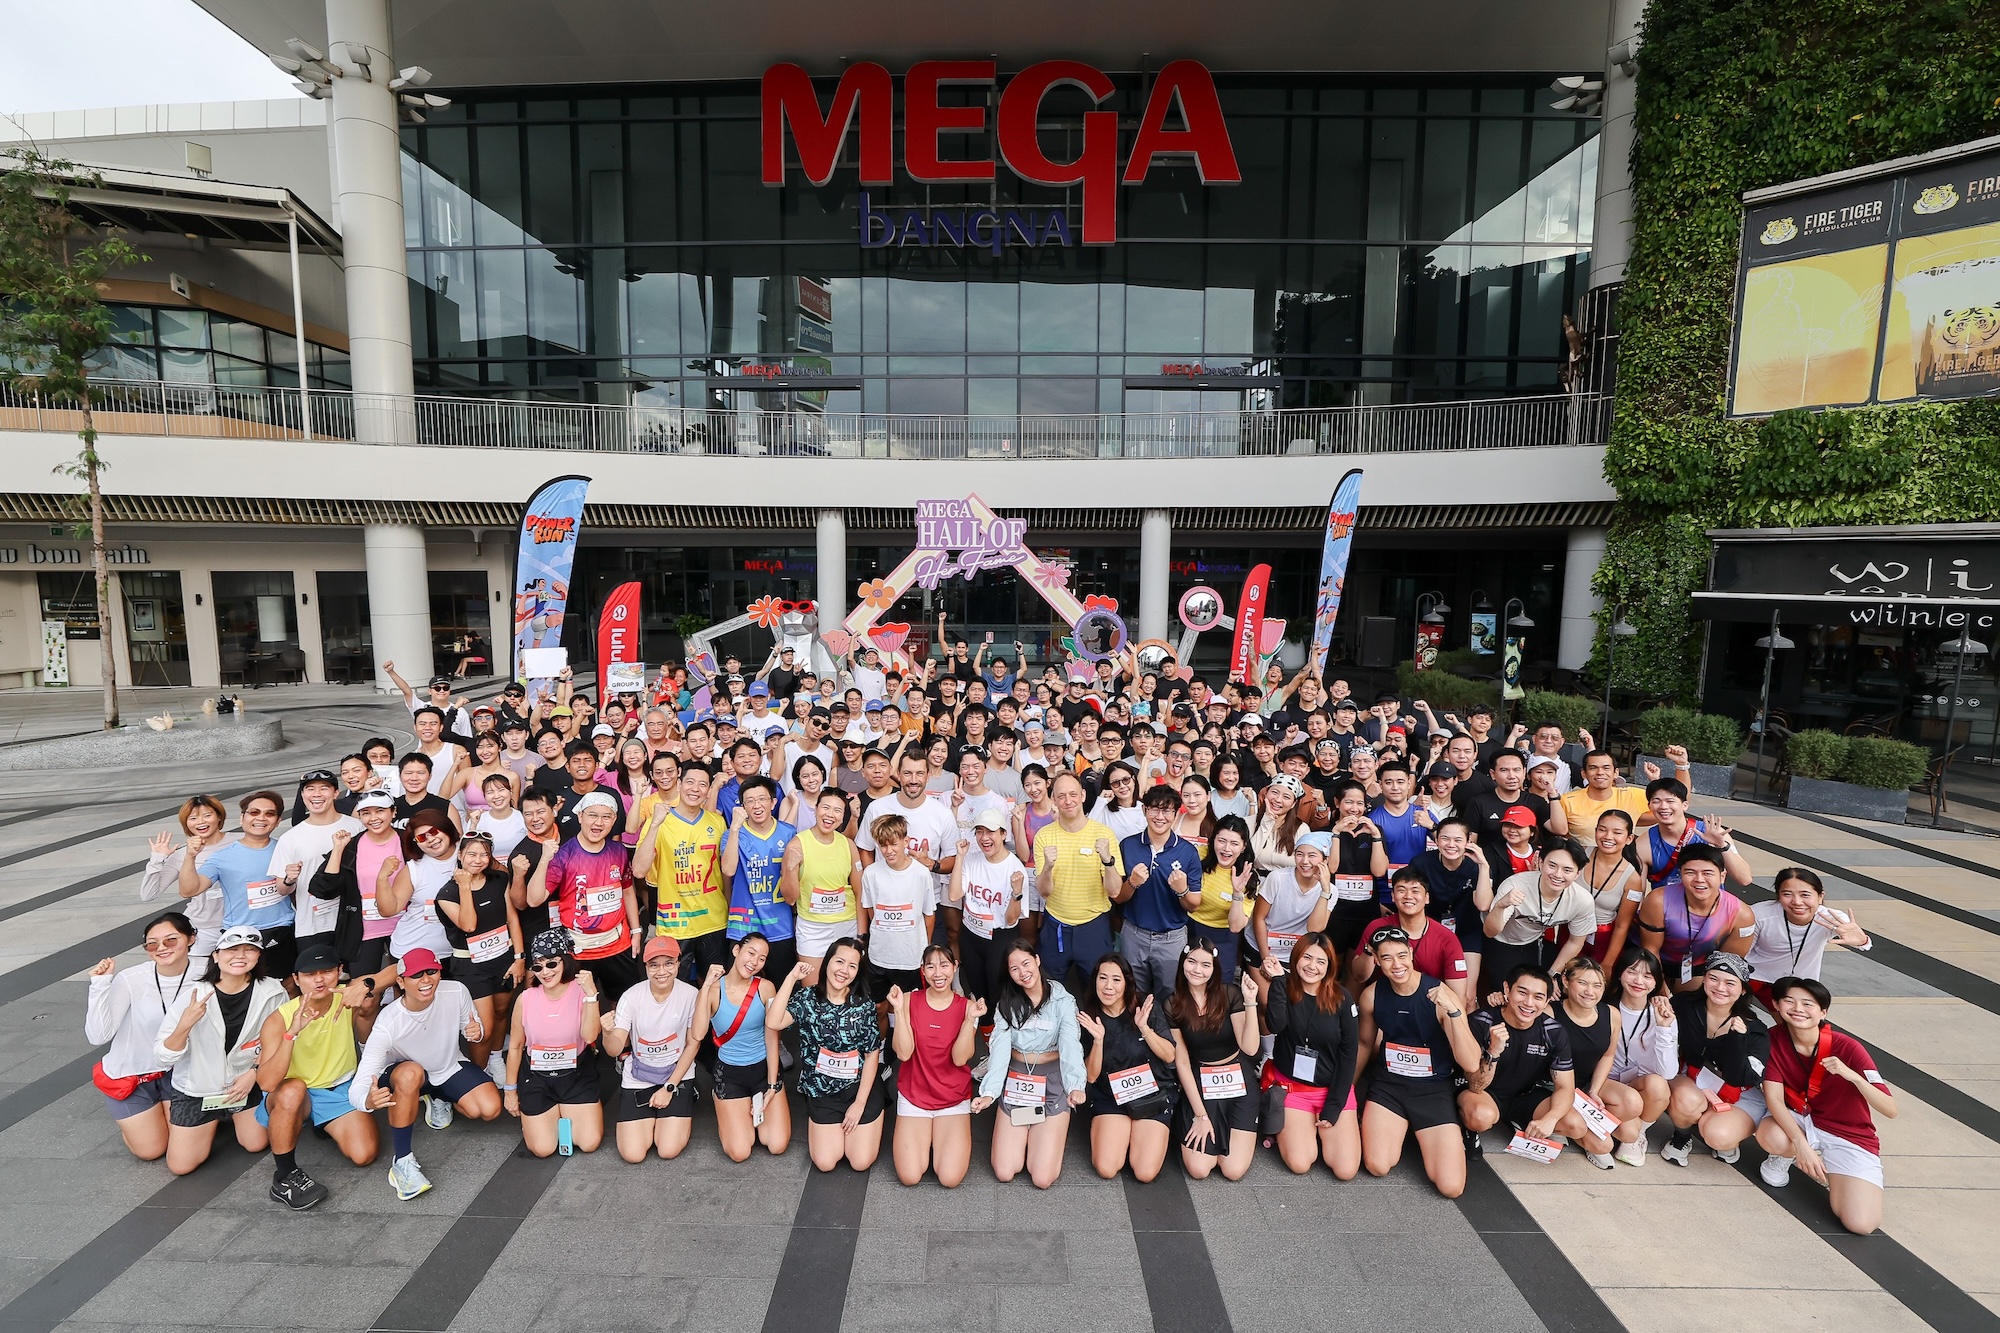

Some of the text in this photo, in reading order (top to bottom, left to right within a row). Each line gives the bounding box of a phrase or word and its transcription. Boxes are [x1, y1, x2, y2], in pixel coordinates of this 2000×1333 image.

[761, 59, 1242, 246] MEGA
[1804, 201, 1882, 230] FIRE TIGER
[1816, 221, 1857, 233] SEOULCIAL
[1861, 216, 1880, 224] CLUB
[742, 365, 782, 380] MEGA
[1162, 364, 1203, 380] MEGA
[919, 503, 971, 518] MEGA
[526, 514, 575, 532] POWER
[534, 528, 565, 544] RUN
[919, 520, 1024, 548] HALL OF
[27, 544, 81, 563] bon
[744, 560, 784, 575] MEGA
[917, 555, 958, 588] Her
[960, 548, 1025, 578] Fame
[1170, 561, 1197, 576] EGA
[907, 837, 929, 851] GA
[597, 891, 616, 901] 005
[821, 895, 839, 903] 094
[884, 912, 903, 920] 002
[967, 914, 983, 927] 003
[480, 936, 500, 949] 023
[543, 1052, 565, 1060] 022
[647, 1045, 668, 1053] 004
[828, 1058, 848, 1068] 011
[1396, 1052, 1419, 1063] 050
[1121, 1075, 1142, 1089] 009
[1212, 1074, 1233, 1084] 010
[1015, 1081, 1034, 1093] 132
[1582, 1102, 1604, 1123] 142
[1525, 1142, 1547, 1154] 143
